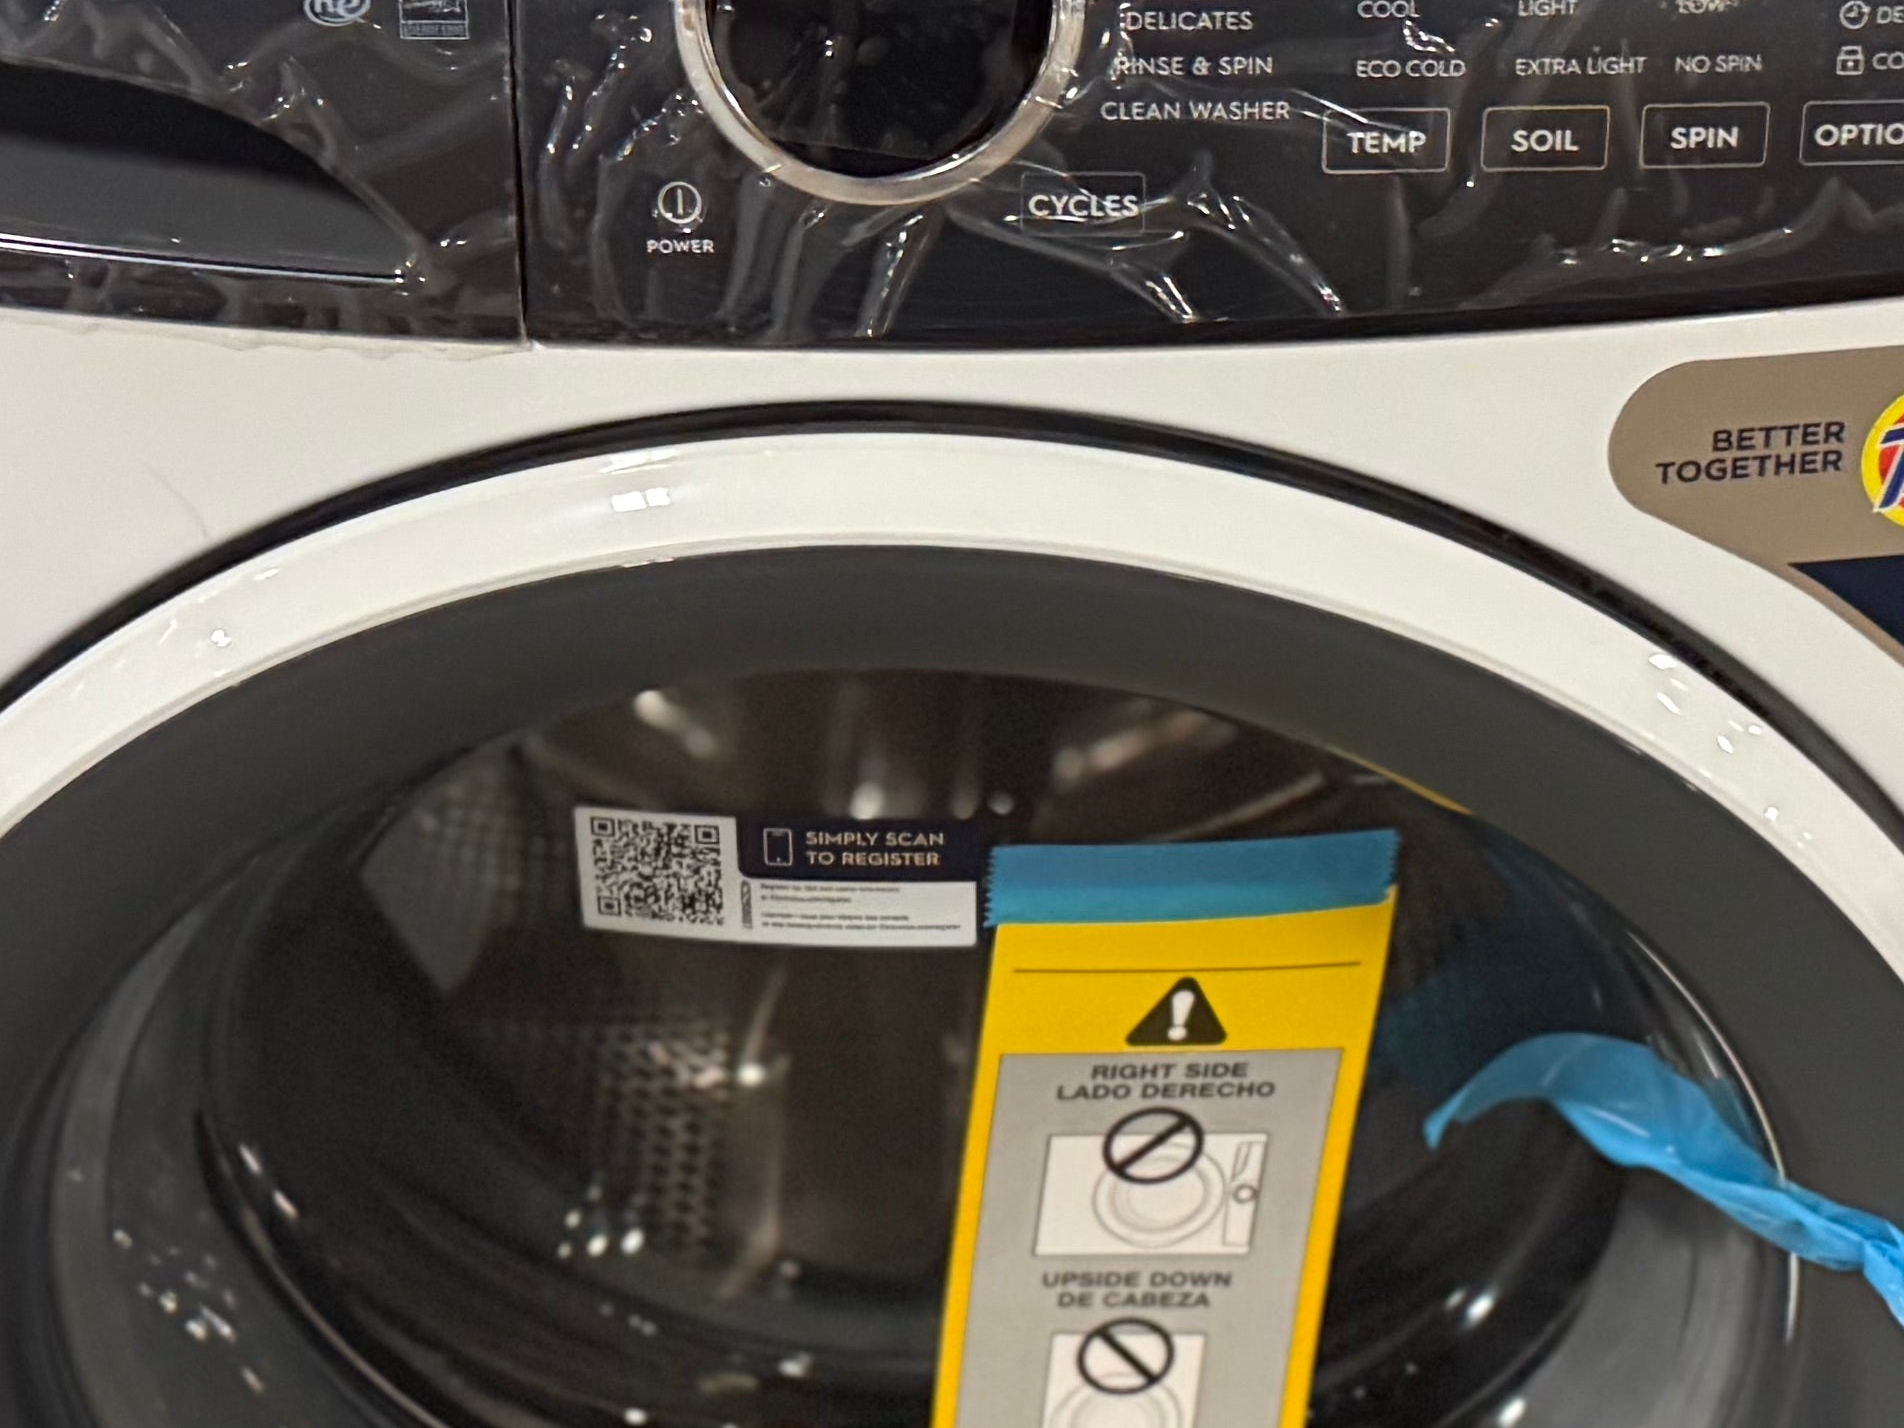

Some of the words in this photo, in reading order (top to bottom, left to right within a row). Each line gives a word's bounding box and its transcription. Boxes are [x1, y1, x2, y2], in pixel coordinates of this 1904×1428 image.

[1357, 0, 1421, 18] COOL
[1124, 11, 1254, 31] DELICATES
[1113, 57, 1185, 75] RINSE
[1192, 57, 1212, 75] &
[1218, 57, 1274, 75] SPIN
[1356, 60, 1401, 78] ECO
[1405, 59, 1467, 77] COLD
[1514, 58, 1581, 76] EXTRA
[1587, 56, 1648, 75] LIGHT
[1675, 55, 1711, 73] NO
[1715, 54, 1764, 72] SPIN
[1100, 101, 1181, 120] CLEAN
[1189, 101, 1291, 120] WASHER
[1346, 131, 1427, 154] TEMP
[1510, 128, 1580, 152] SOIL
[1670, 125, 1739, 149] SPIN
[1028, 194, 1140, 218] CYCLES
[646, 239, 715, 254] POWER
[1712, 422, 1846, 452] BETTER
[1655, 450, 1843, 485] TOGETHER
[805, 831, 879, 847] SIMPLY
[885, 832, 945, 847] SCAN
[806, 851, 835, 866] TO
[841, 852, 941, 867] REGISTER
[1091, 1063, 1176, 1080] RIGHT
[1184, 1062, 1250, 1079] SIDE
[1057, 1083, 1132, 1101] LADO
[1140, 1081, 1277, 1099] DERECHO
[1042, 1271, 1141, 1289] UPSIDE
[1149, 1271, 1233, 1288] DOWN
[1057, 1291, 1093, 1308] DE
[1103, 1291, 1211, 1308] CABEZA
